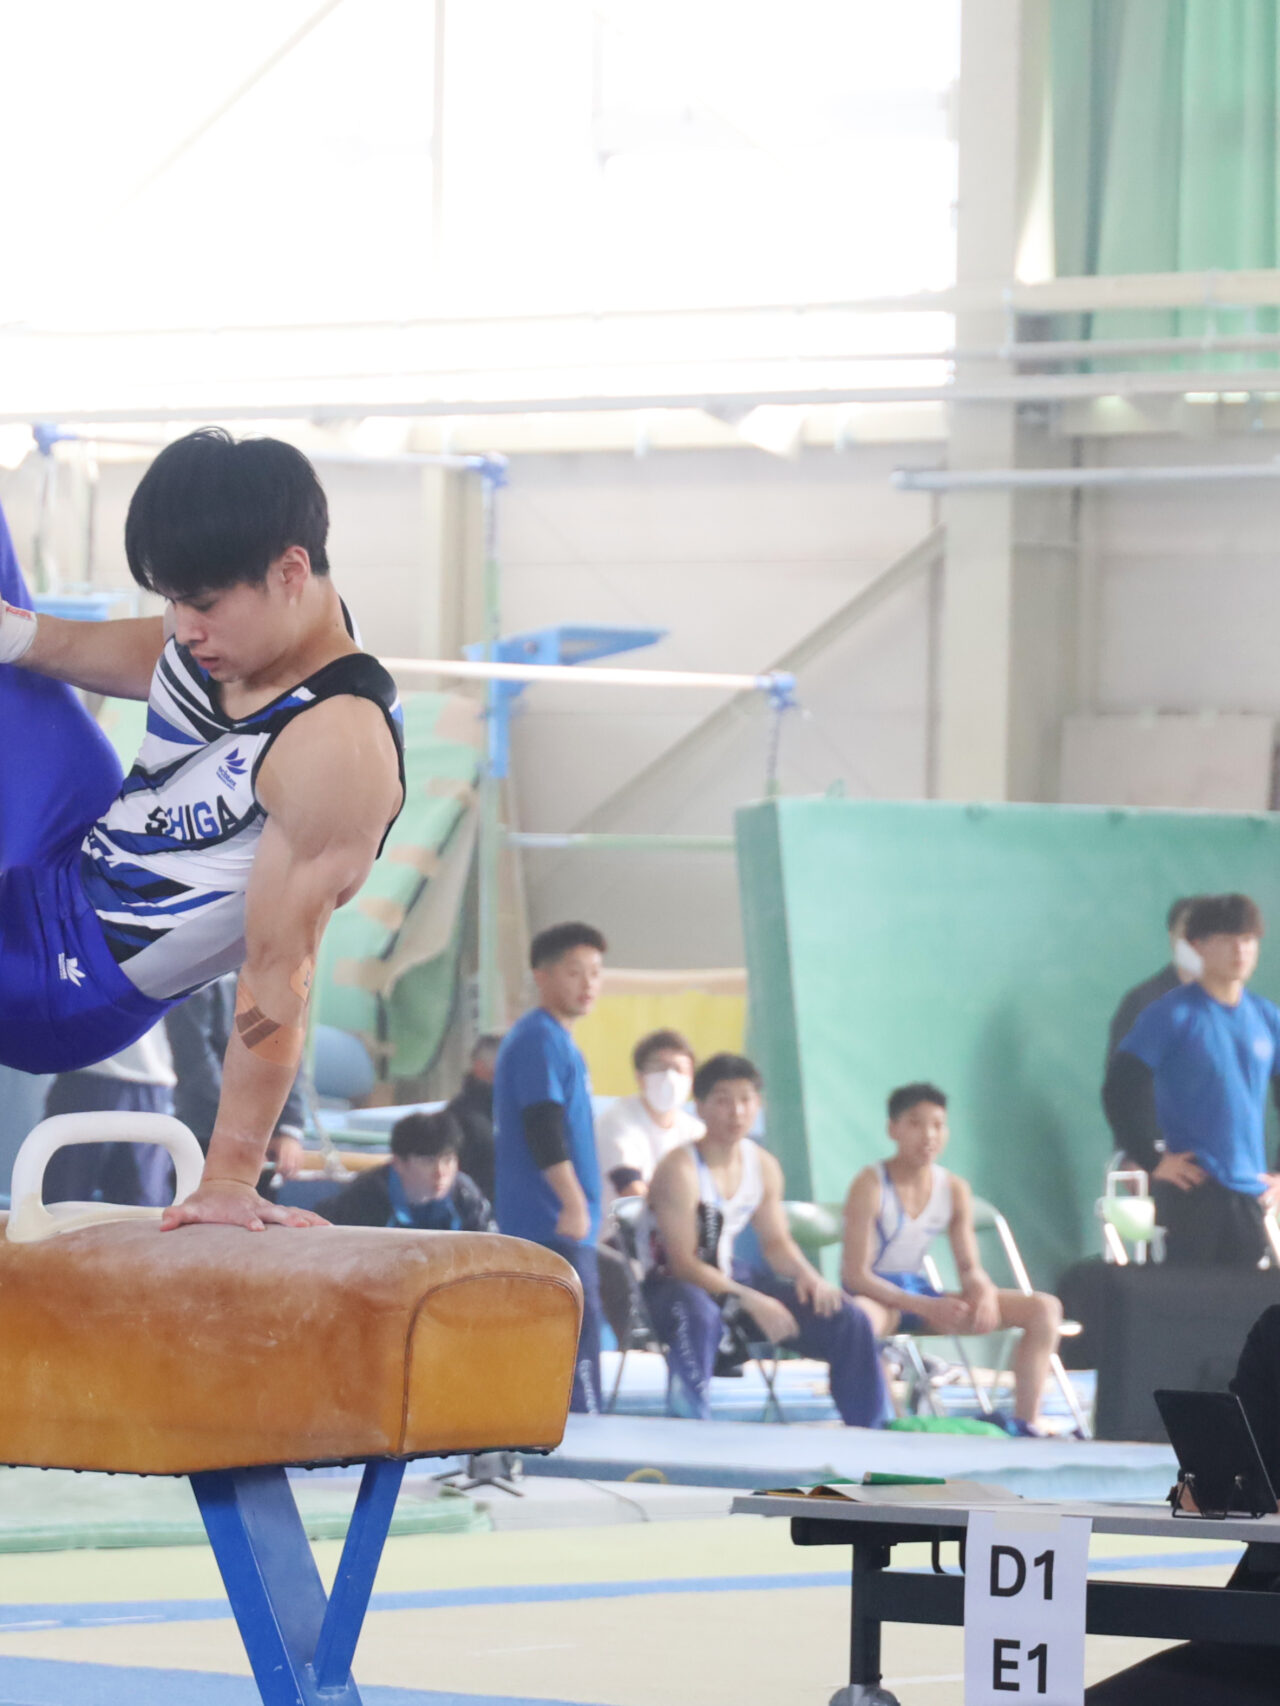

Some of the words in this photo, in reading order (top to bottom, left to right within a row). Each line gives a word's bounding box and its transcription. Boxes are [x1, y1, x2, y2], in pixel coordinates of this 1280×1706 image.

[145, 794, 240, 840] SHIGA
[990, 1544, 1055, 1600] D1
[993, 1638, 1048, 1694] E1
